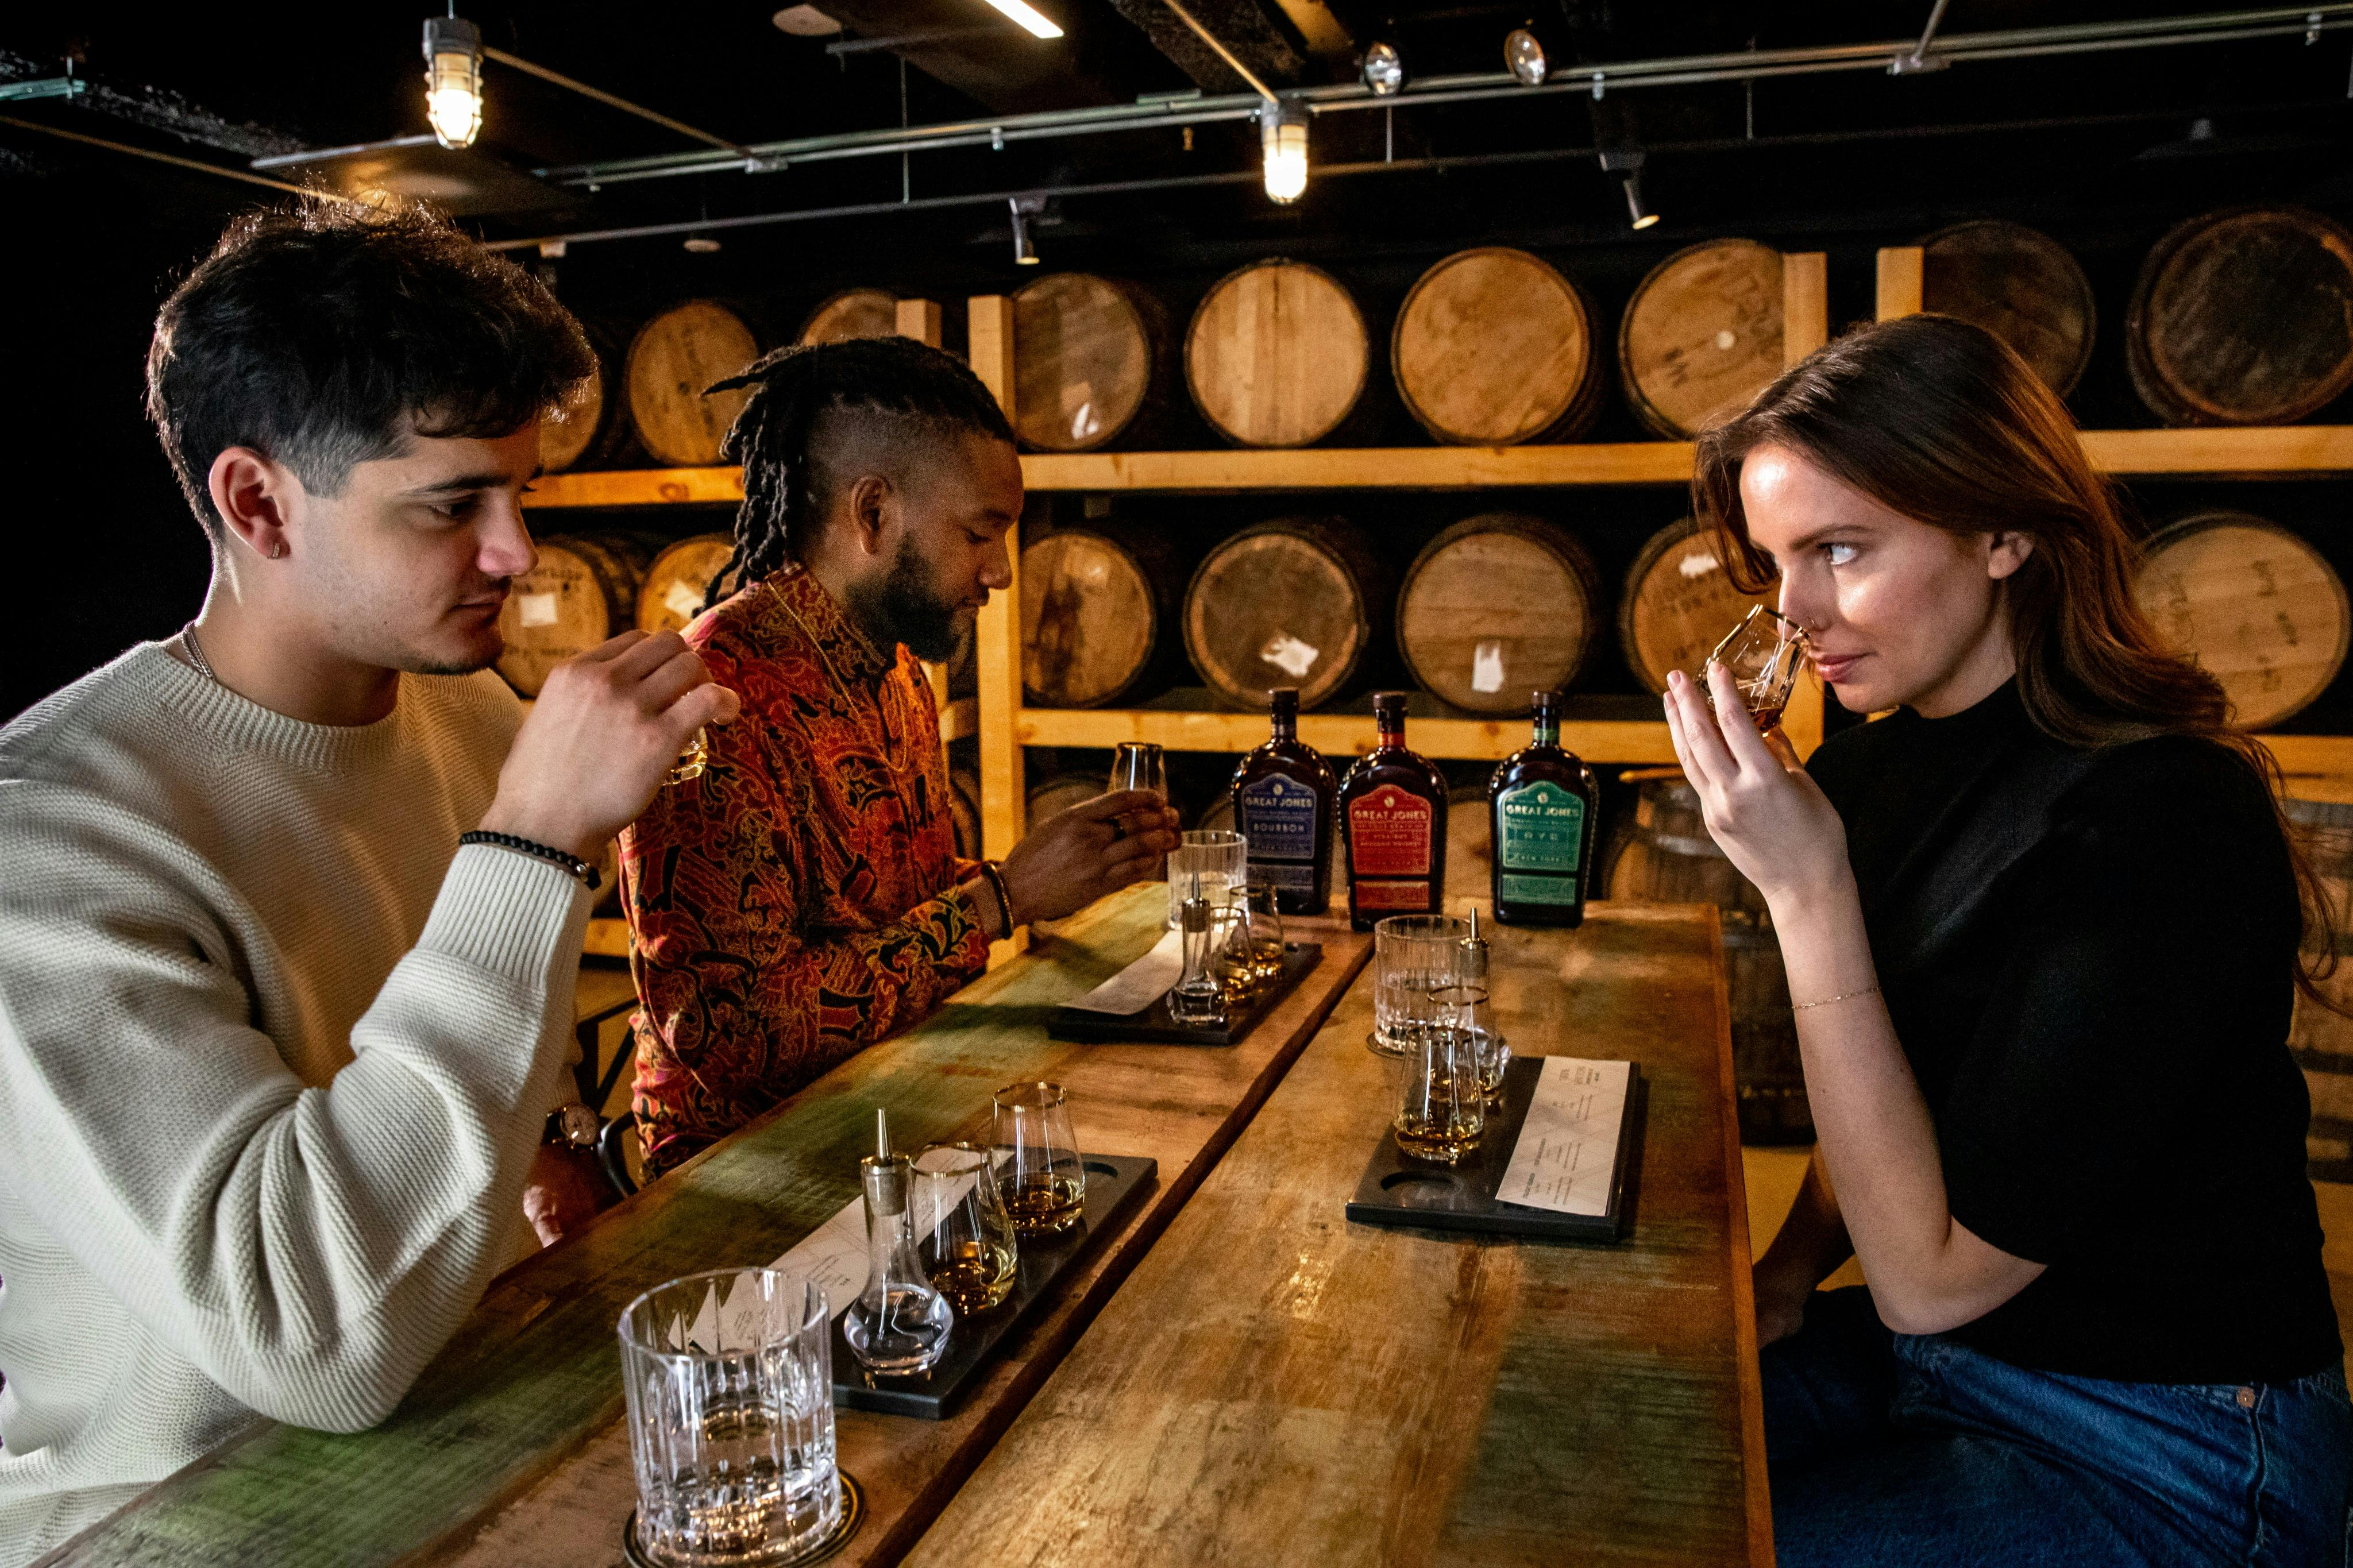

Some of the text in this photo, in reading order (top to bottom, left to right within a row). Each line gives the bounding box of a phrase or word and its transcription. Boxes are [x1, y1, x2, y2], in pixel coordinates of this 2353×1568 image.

[1245, 797, 1313, 808] GREAT JONES
[1354, 810, 1427, 820] GREAT JONES
[1506, 805, 1579, 817] GREAT JONES
[1253, 823, 1305, 833] BOURBON
[1524, 832, 1558, 840] RYE
